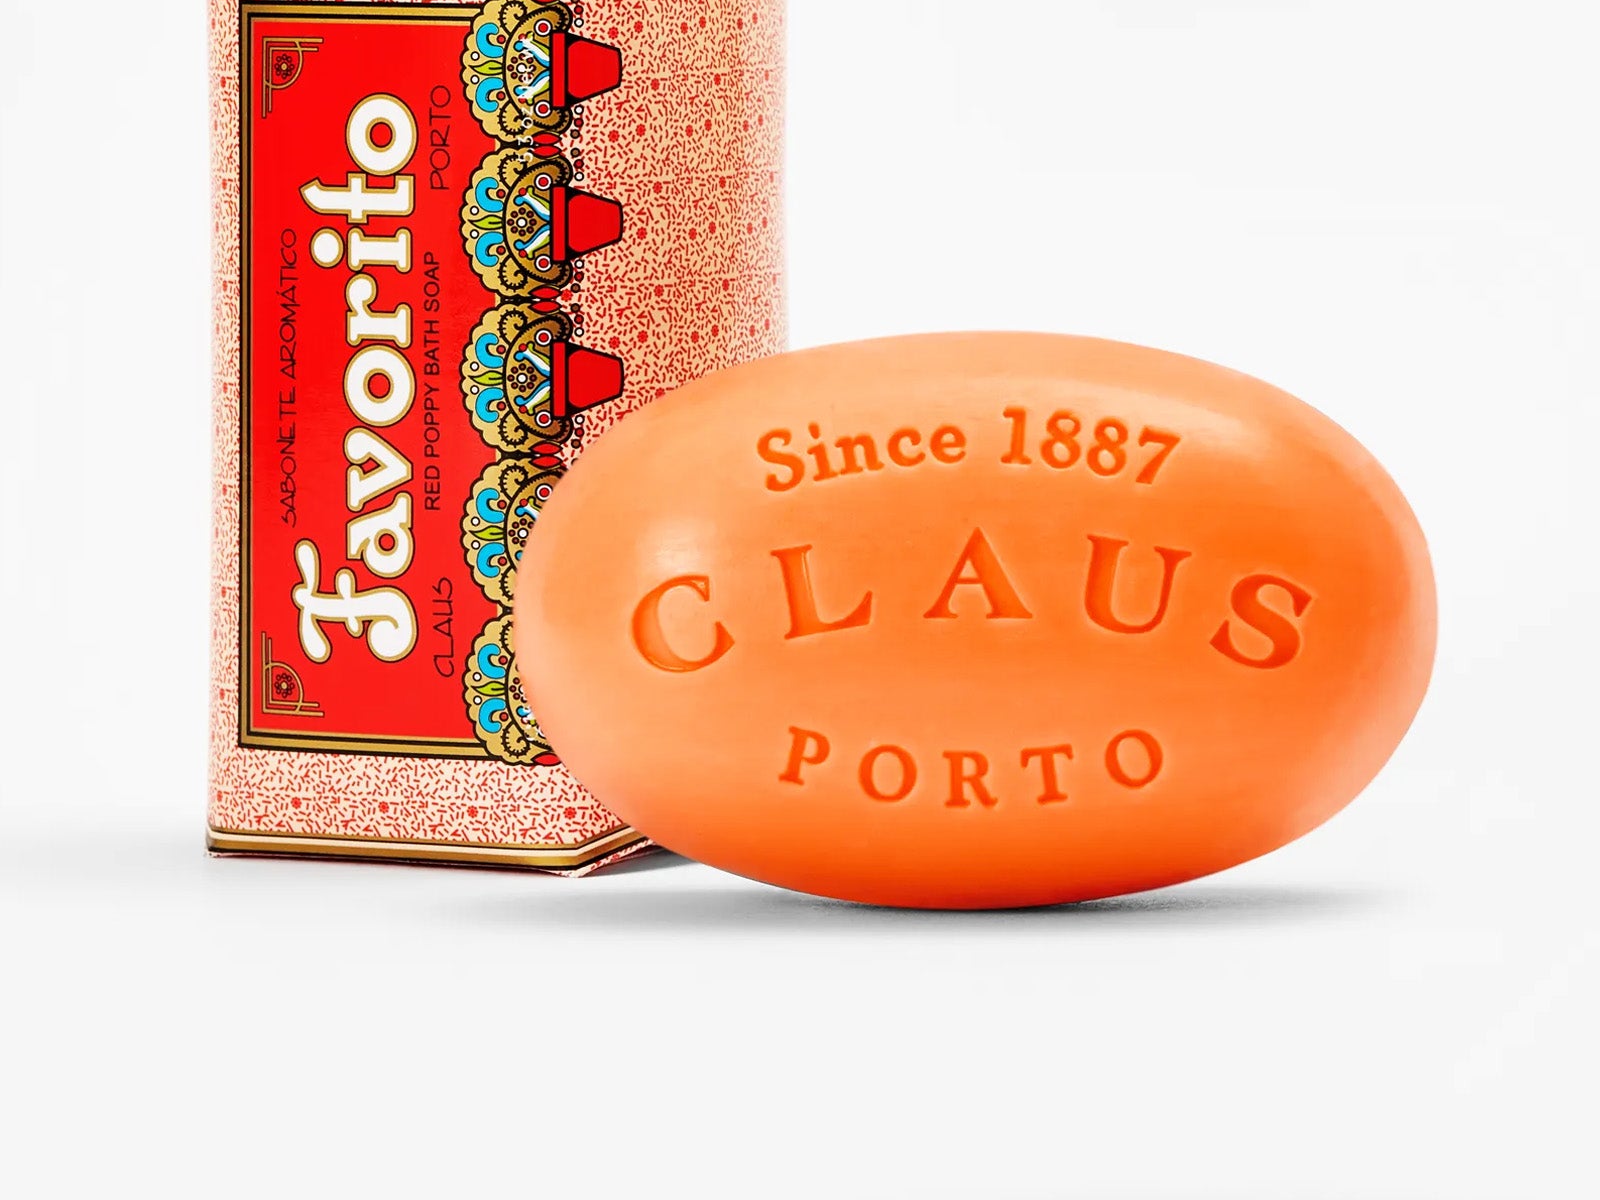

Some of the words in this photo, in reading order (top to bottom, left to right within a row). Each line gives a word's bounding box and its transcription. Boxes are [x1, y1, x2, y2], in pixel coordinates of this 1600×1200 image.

[430, 85, 451, 190] PORTO
[520, 107, 533, 129] oz
[276, 228, 300, 379] AROMÁTICO
[424, 250, 440, 313] SOAP
[292, 93, 418, 663] Favorito
[424, 319, 440, 377] BATH
[276, 390, 298, 528] SABONETE
[424, 382, 440, 461] POPPY
[756, 421, 967, 492] Since
[1000, 405, 1181, 485] 1887
[424, 465, 440, 511] RED
[433, 576, 455, 677] CLAUS
[631, 526, 1314, 673] CLAUS
[778, 725, 1164, 808] PORTO
